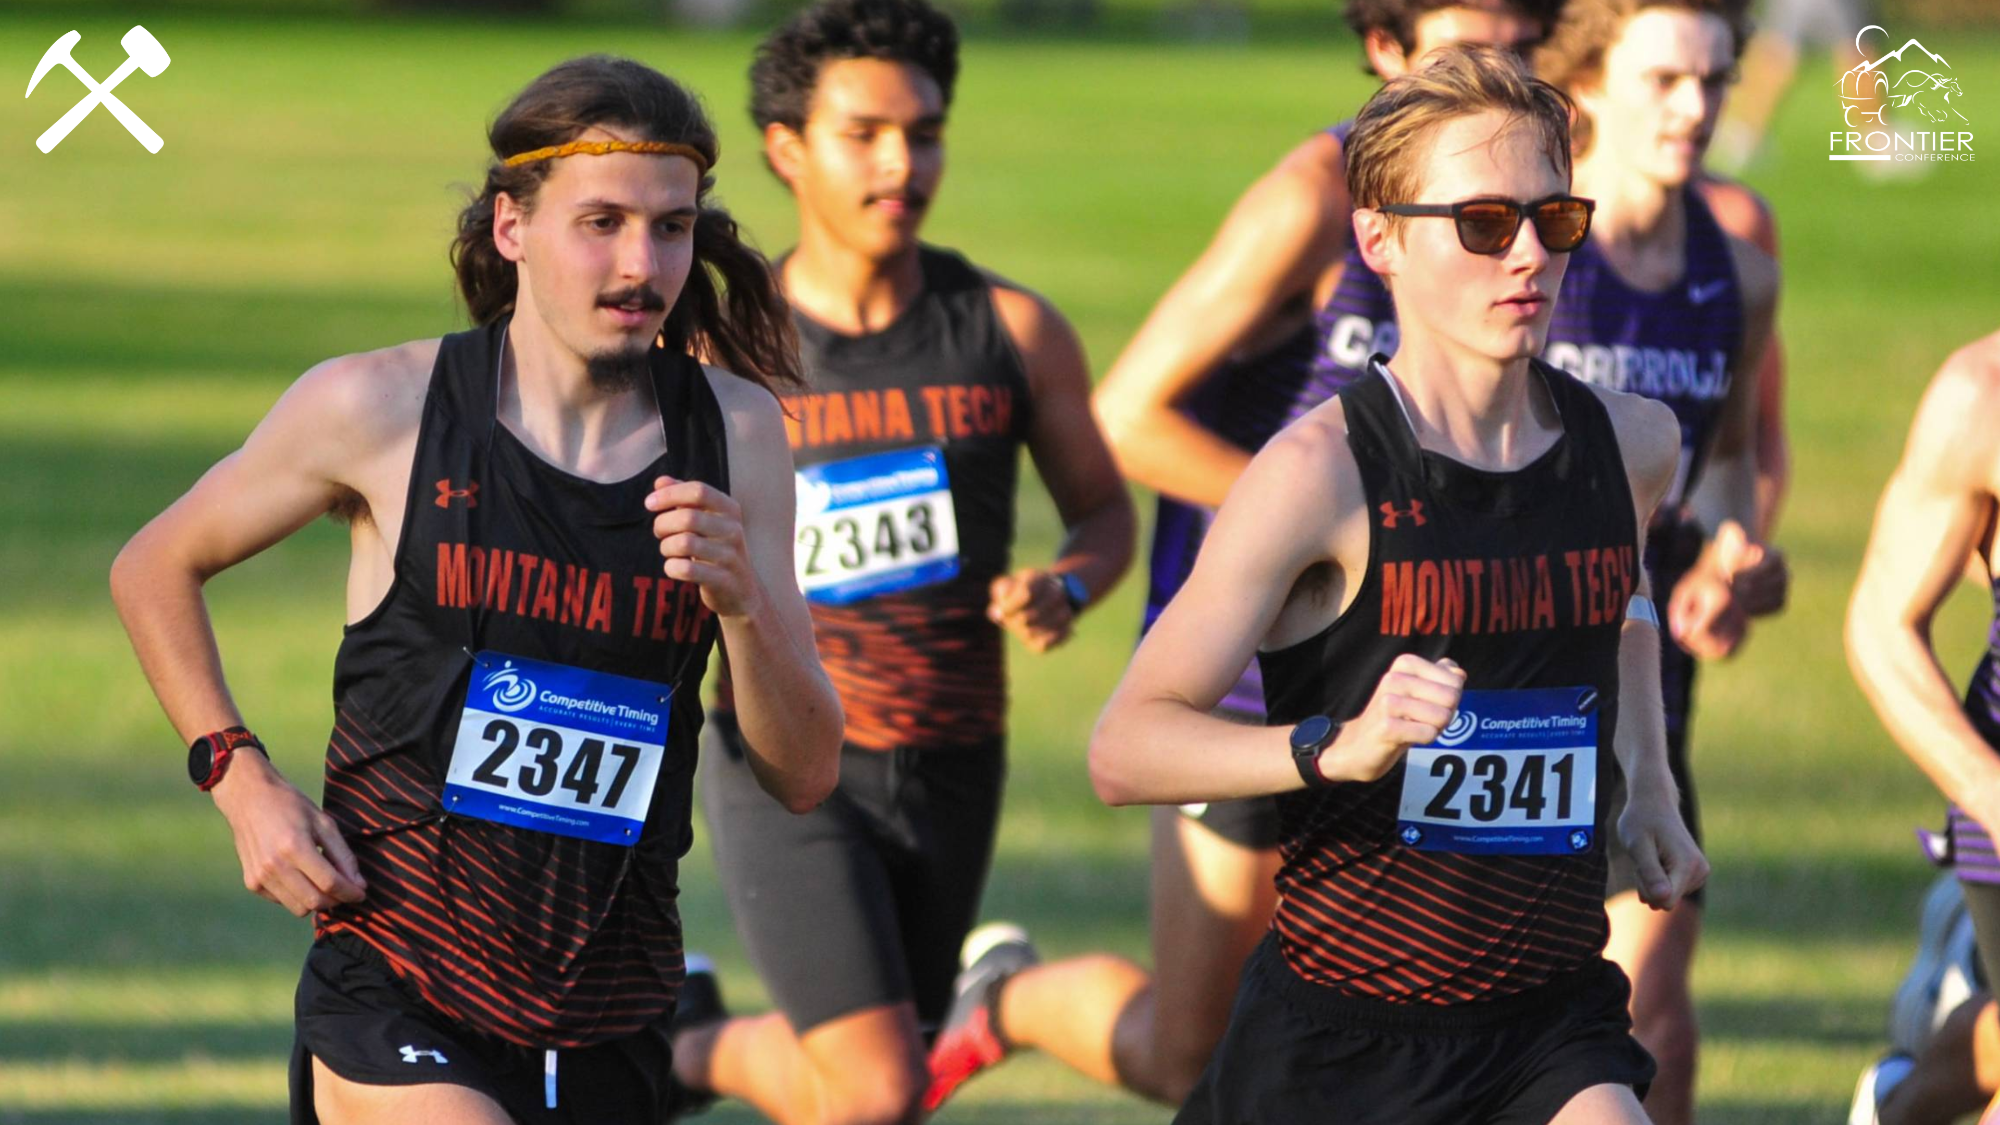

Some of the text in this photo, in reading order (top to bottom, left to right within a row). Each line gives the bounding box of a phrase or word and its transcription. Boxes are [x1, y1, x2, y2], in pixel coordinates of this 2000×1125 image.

[781, 384, 1013, 448] NTANA TECH
[798, 502, 937, 577] 2343
[436, 542, 613, 634] MONTANA
[1380, 554, 1556, 637] MONTANA
[539, 705, 576, 718] ACCURATE
[472, 719, 641, 809] 2347
[1424, 753, 1575, 822] 2341
